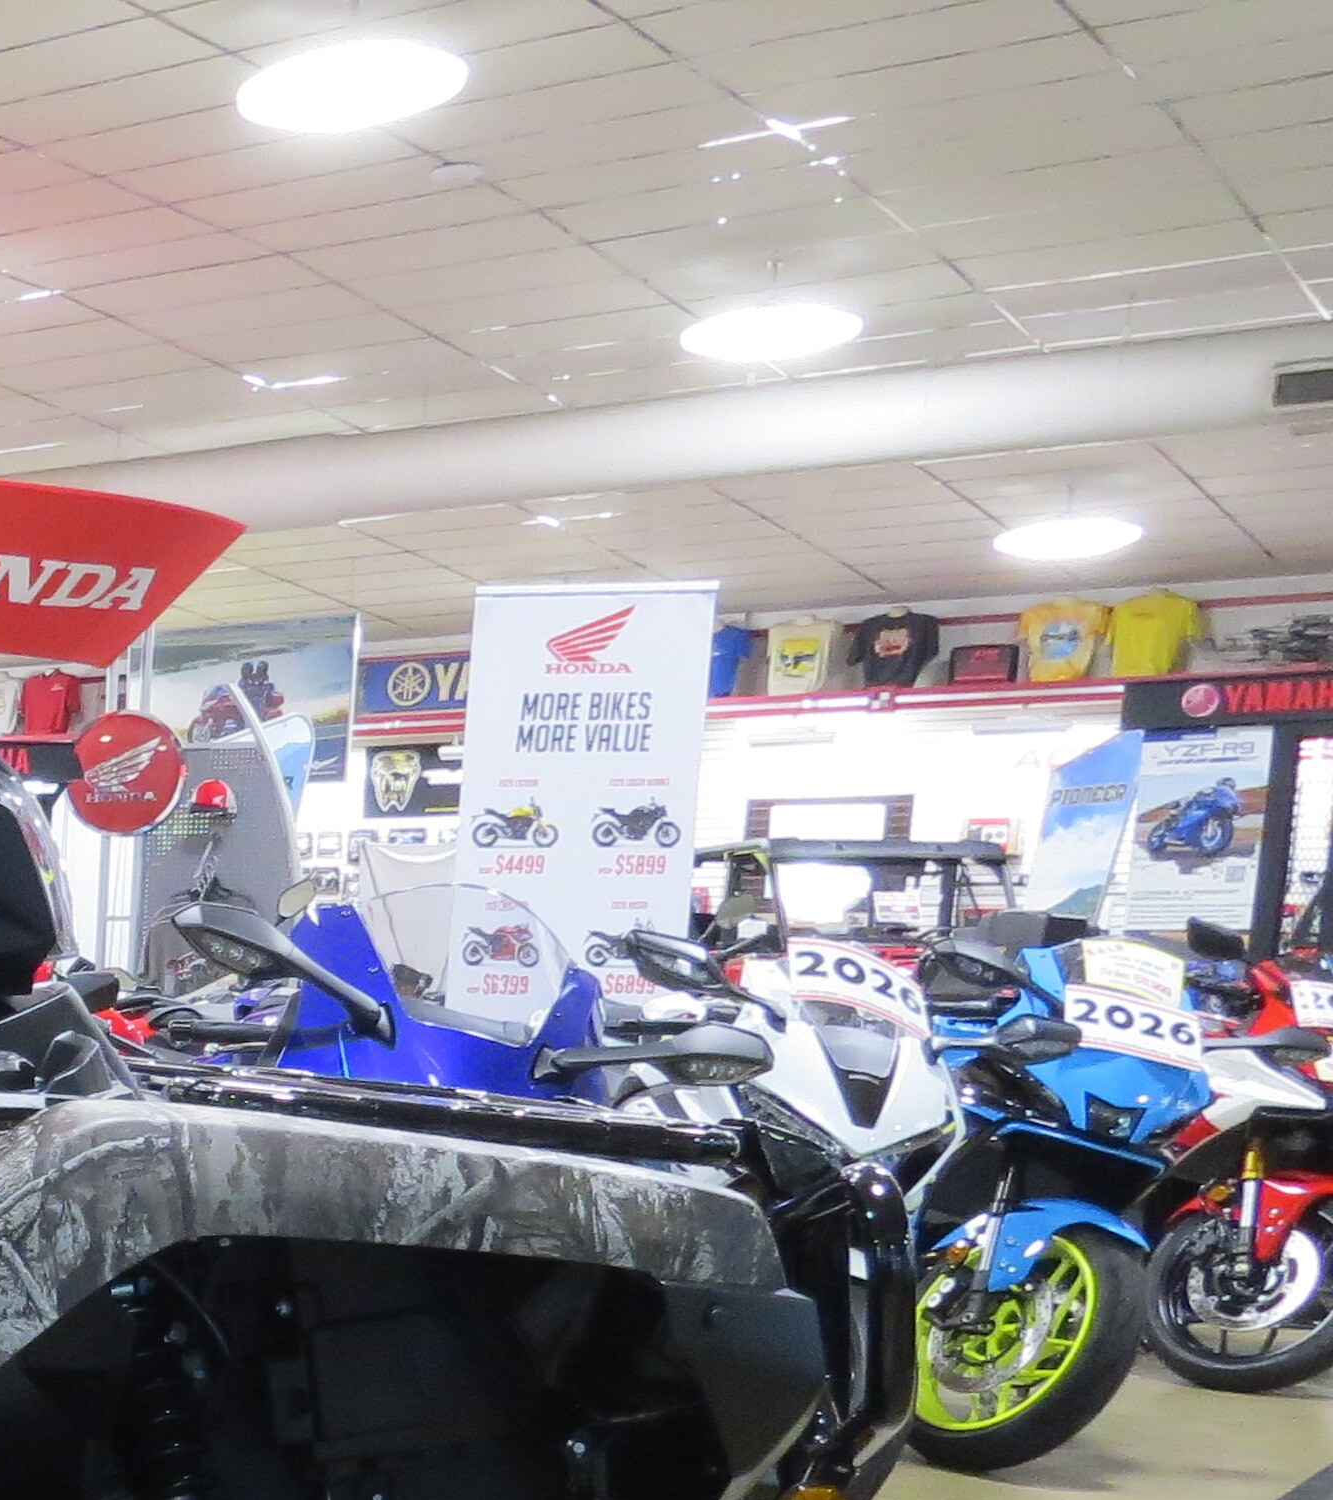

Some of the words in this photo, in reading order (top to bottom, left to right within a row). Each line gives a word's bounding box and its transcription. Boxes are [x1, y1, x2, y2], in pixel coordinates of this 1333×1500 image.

[544, 663, 633, 675] HONDA
[520, 692, 582, 721] MORE
[587, 692, 653, 721] BIKES
[1226, 679, 1333, 714] YAMAH
[515, 724, 577, 753] MORE
[584, 723, 654, 753] VALUE
[1163, 741, 1256, 758] YZF-R9
[84, 790, 158, 804] HONDA
[495, 854, 546, 876] $4499
[614, 854, 667, 876] $5899
[482, 973, 530, 996] $6399
[795, 950, 922, 1016] 2026
[1071, 997, 1197, 1047] 2026
